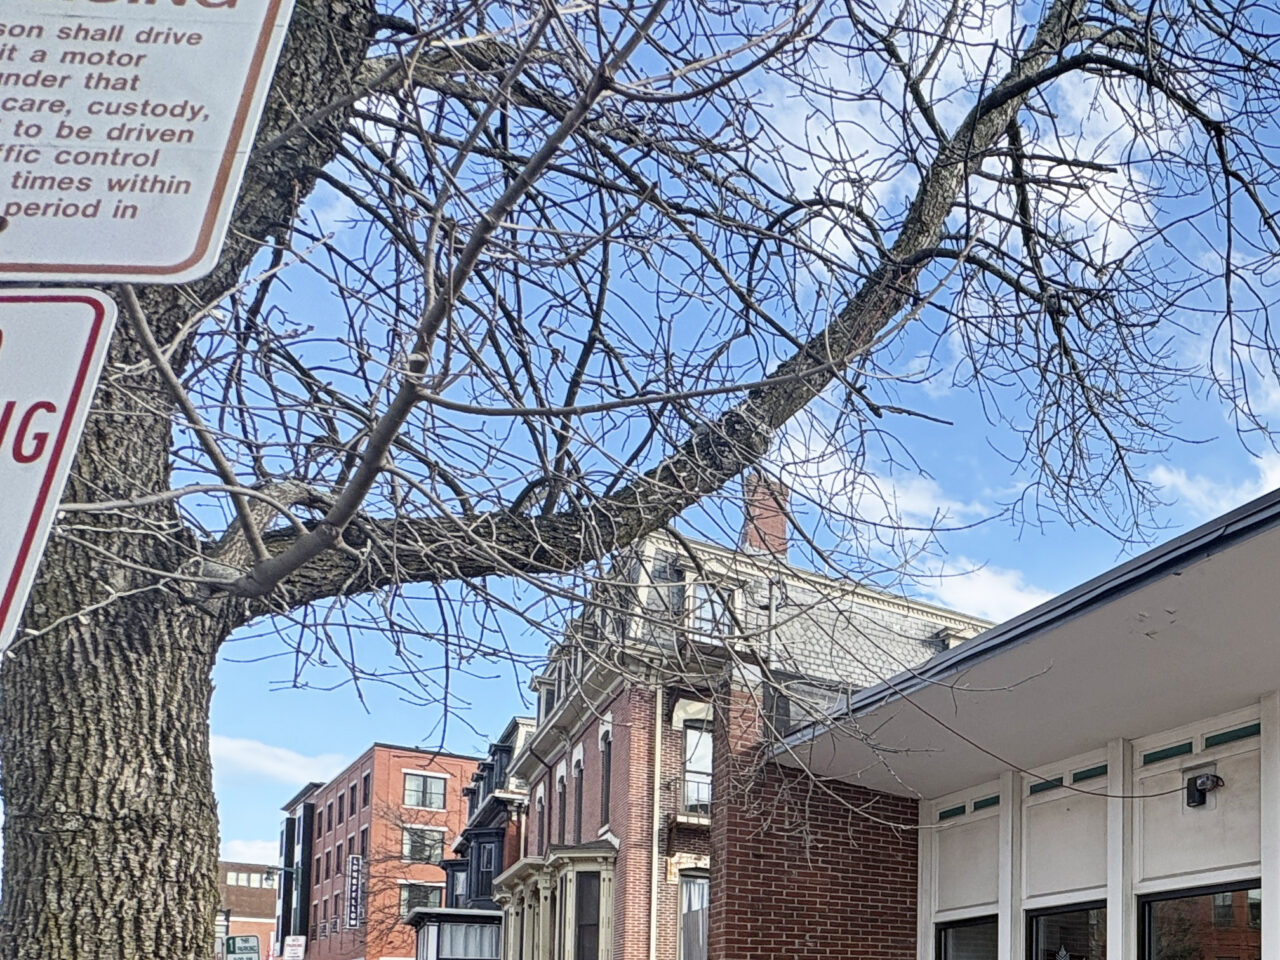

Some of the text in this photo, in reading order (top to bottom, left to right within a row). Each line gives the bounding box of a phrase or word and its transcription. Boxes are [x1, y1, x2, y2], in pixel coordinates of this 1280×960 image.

[57, 22, 124, 42] shall
[135, 27, 203, 45] drive
[29, 49, 47, 63] a
[60, 50, 147, 67] motor
[0, 69, 140, 91] nder that
[1, 97, 209, 122] care, custody,
[13, 120, 194, 143] to be driven
[0, 144, 160, 167] fic control
[11, 171, 191, 194] times within
[4, 199, 138, 219] period in
